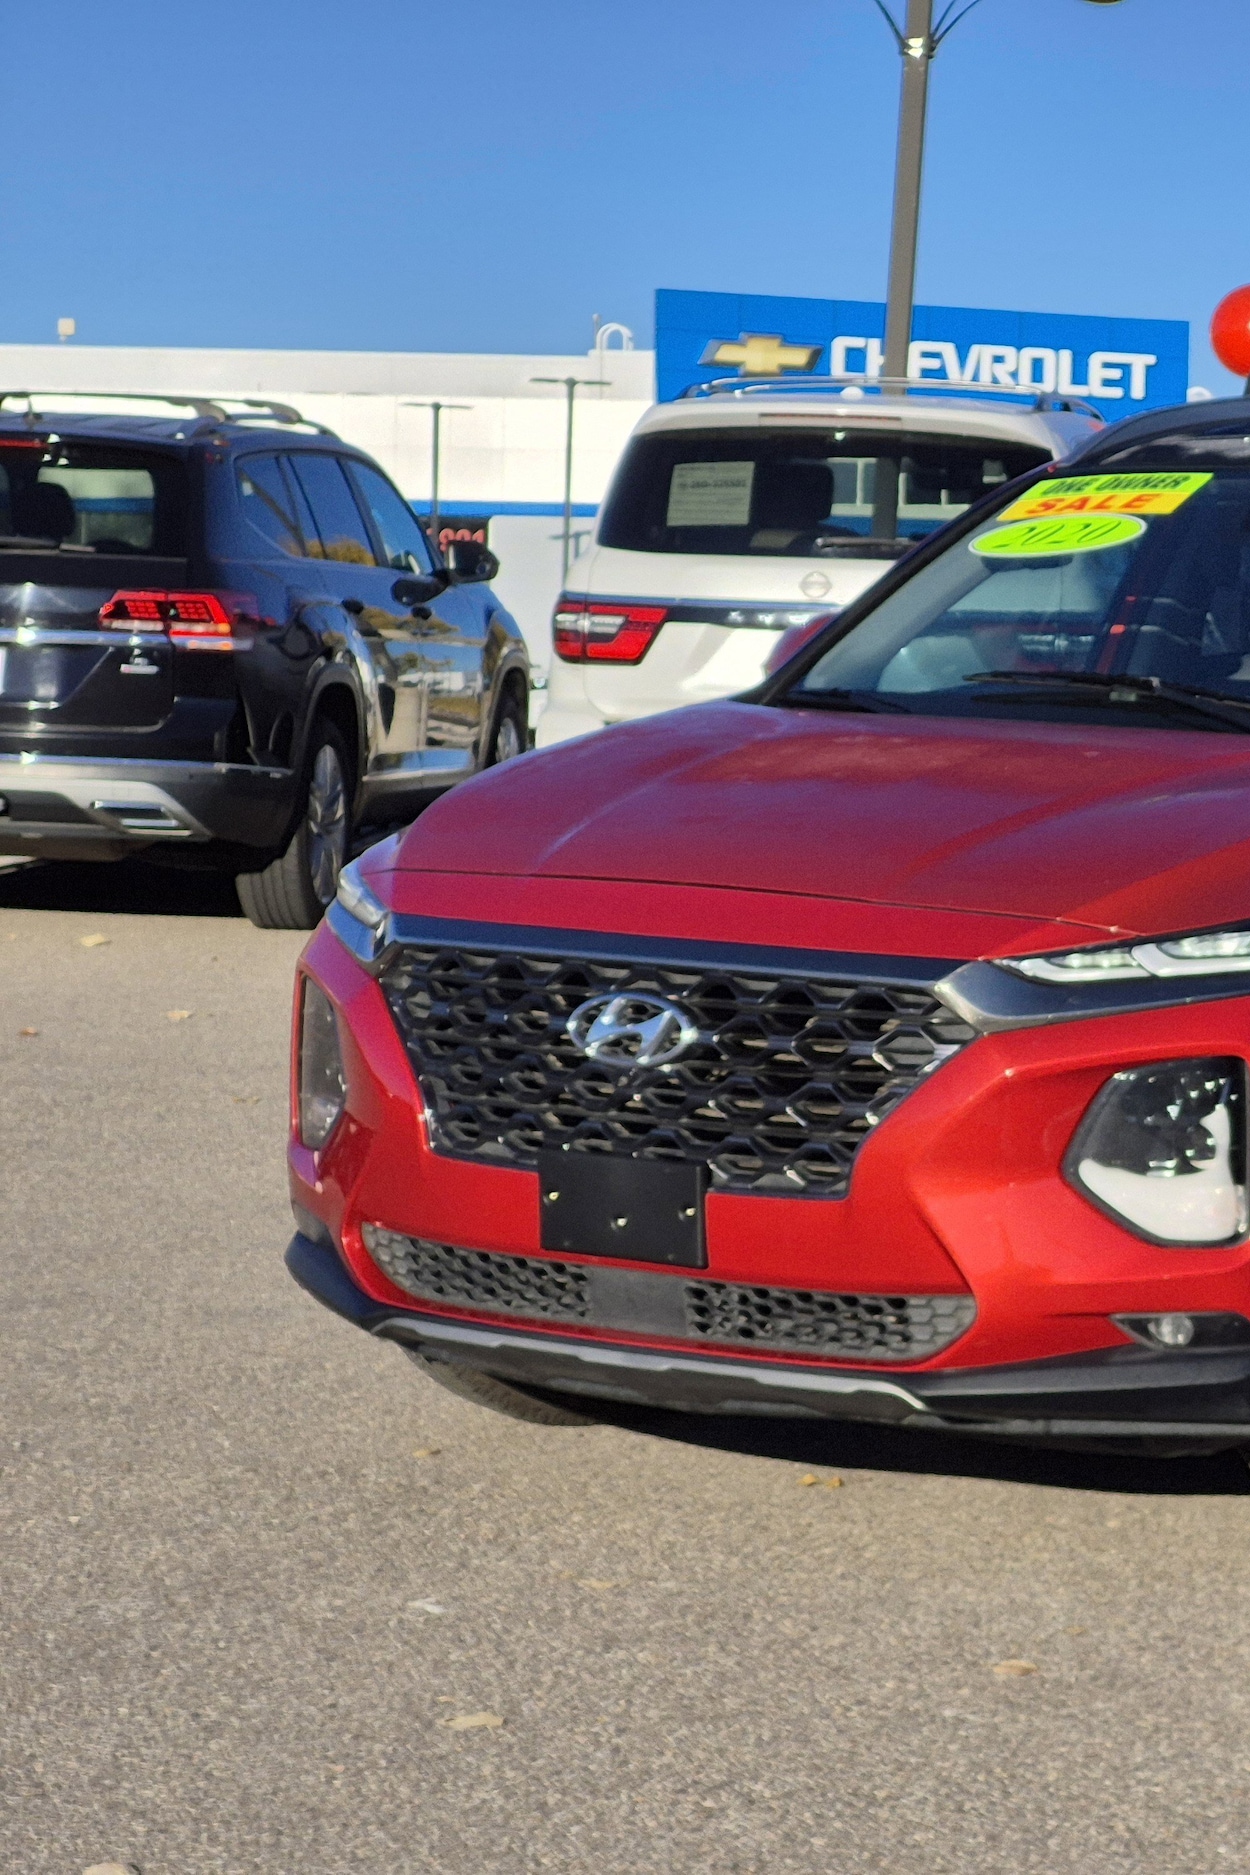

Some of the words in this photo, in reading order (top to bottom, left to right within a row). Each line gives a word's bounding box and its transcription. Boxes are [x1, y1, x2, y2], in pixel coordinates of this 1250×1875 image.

[1095, 475, 1192, 492] OWNER
[1026, 493, 1163, 514] SALE
[992, 520, 1122, 549] 2020
